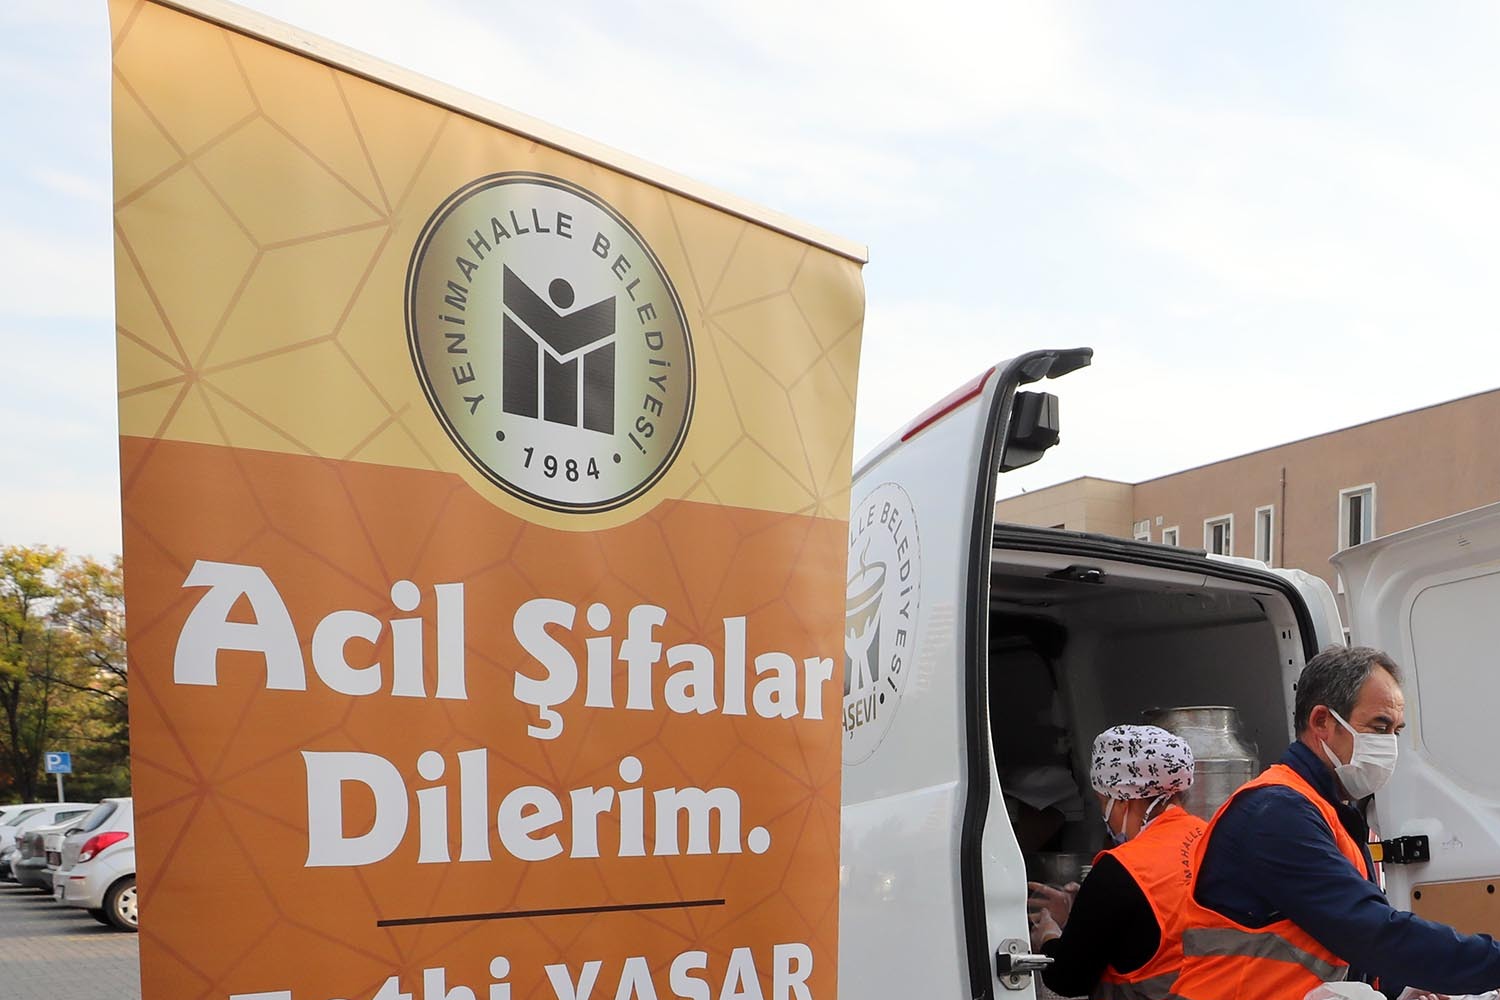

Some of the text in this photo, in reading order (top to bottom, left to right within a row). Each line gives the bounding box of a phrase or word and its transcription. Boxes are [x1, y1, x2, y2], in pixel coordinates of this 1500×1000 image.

[439, 208, 671, 455] YENİMAHALLE BELEDİYESİ
[523, 446, 600, 482] 1984
[173, 559, 834, 740] Acil Şifalar
[46, 754, 61, 771] P
[301, 747, 771, 868] Dilerim.
